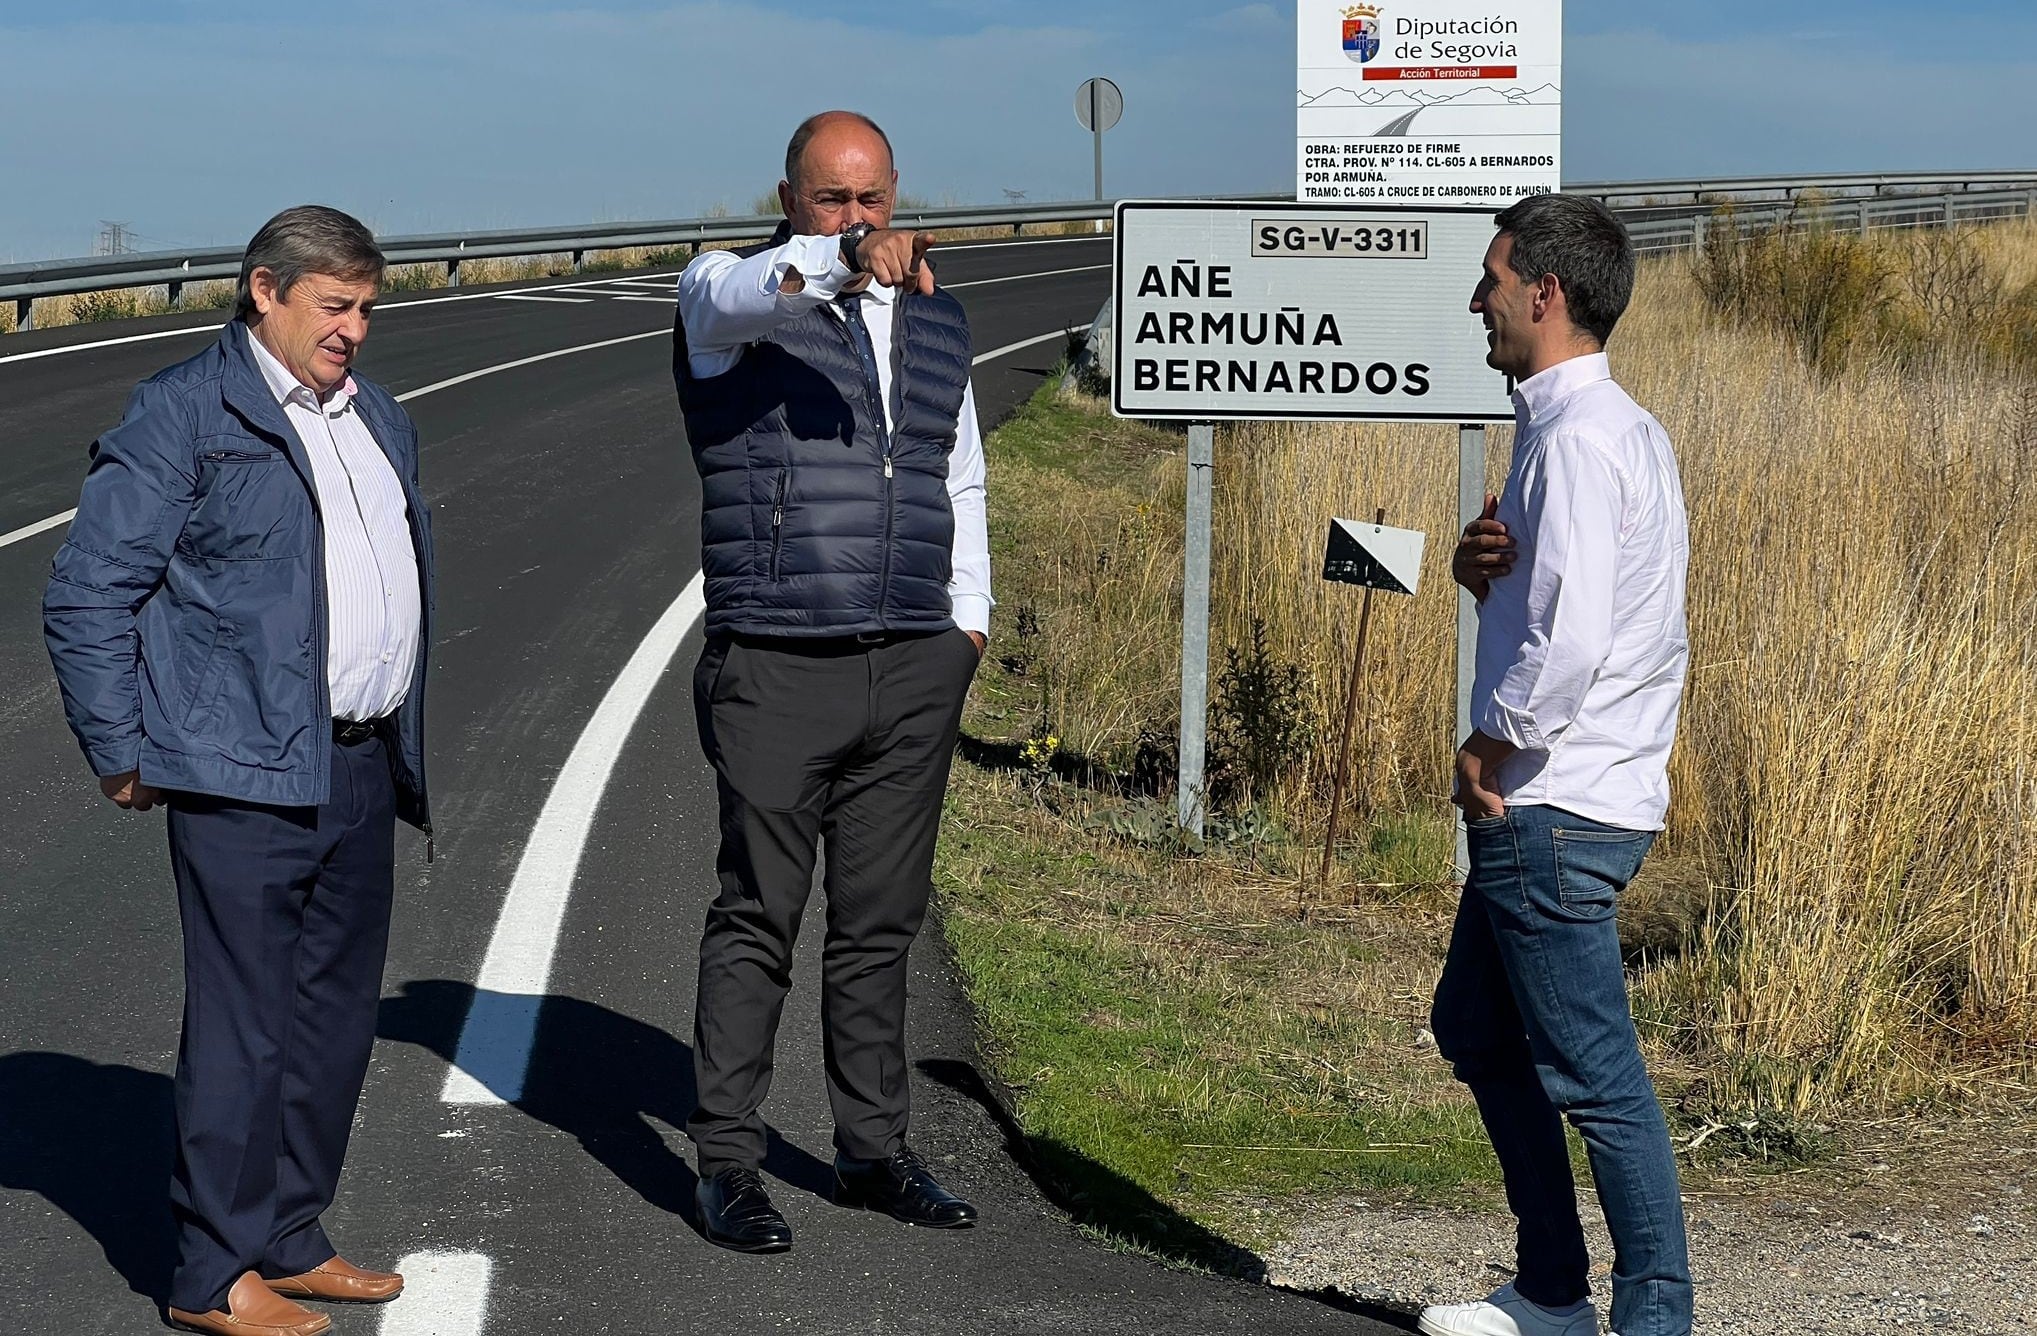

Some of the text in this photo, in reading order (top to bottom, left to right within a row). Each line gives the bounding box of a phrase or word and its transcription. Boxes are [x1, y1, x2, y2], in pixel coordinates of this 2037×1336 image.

[1396, 16, 1517, 39] Diputación
[1395, 41, 1517, 63] de Segovia
[1400, 68, 1480, 78] Acción Territorial
[1305, 144, 1461, 154] OBRA: REFUERZO DE FIRME
[1305, 158, 1339, 168] CTRA.
[1343, 157, 1377, 167] PROV.
[1399, 157, 1422, 167] 114.
[1426, 157, 1465, 167] CL-605
[1469, 157, 1477, 166] A
[1480, 156, 1554, 166] BERNARDOS
[1305, 169, 1387, 182] POR ARMUÑA.
[1305, 187, 1341, 197] TRAMO:
[1343, 187, 1375, 197] CL-605
[1378, 187, 1384, 196] A
[1387, 187, 1419, 196] CRUCE
[1422, 187, 1435, 196] DE
[1438, 186, 1497, 196] CARBONERO
[1500, 186, 1512, 196] DE
[1258, 227, 1421, 252] SG-V-3311
[1137, 259, 1233, 298] AÑE
[1135, 307, 1343, 346] ARMUÑA
[1134, 359, 1431, 396] BERNARDOS
